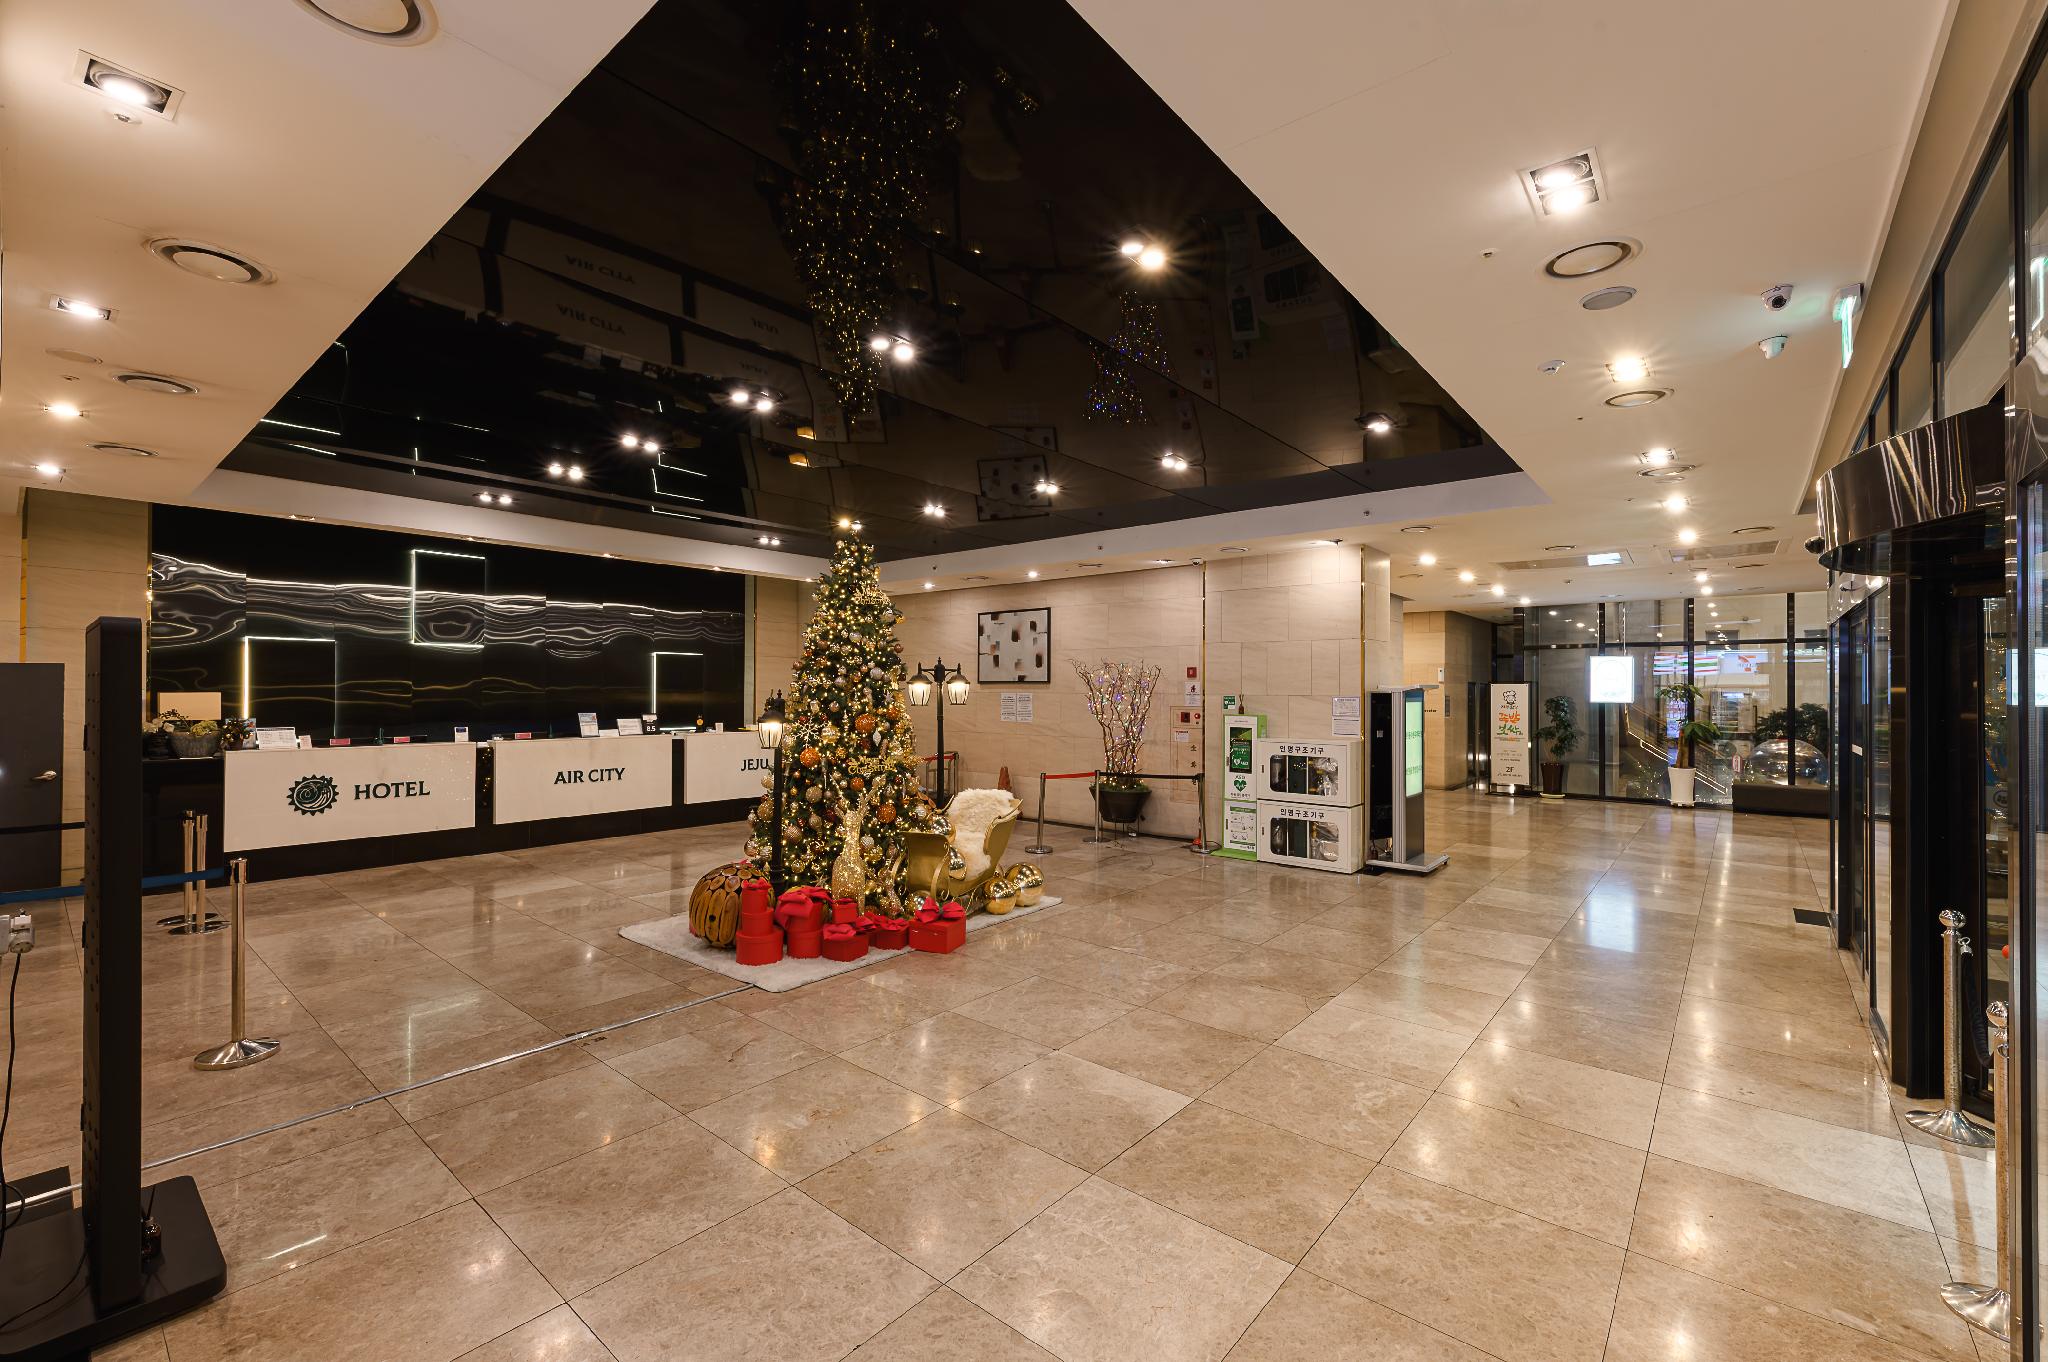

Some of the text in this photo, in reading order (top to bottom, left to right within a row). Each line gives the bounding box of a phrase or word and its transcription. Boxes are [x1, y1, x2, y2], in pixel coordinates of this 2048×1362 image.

[740, 758, 769, 772] JEJU
[553, 767, 625, 785] AIR CITY
[354, 780, 431, 800] HOTEL
